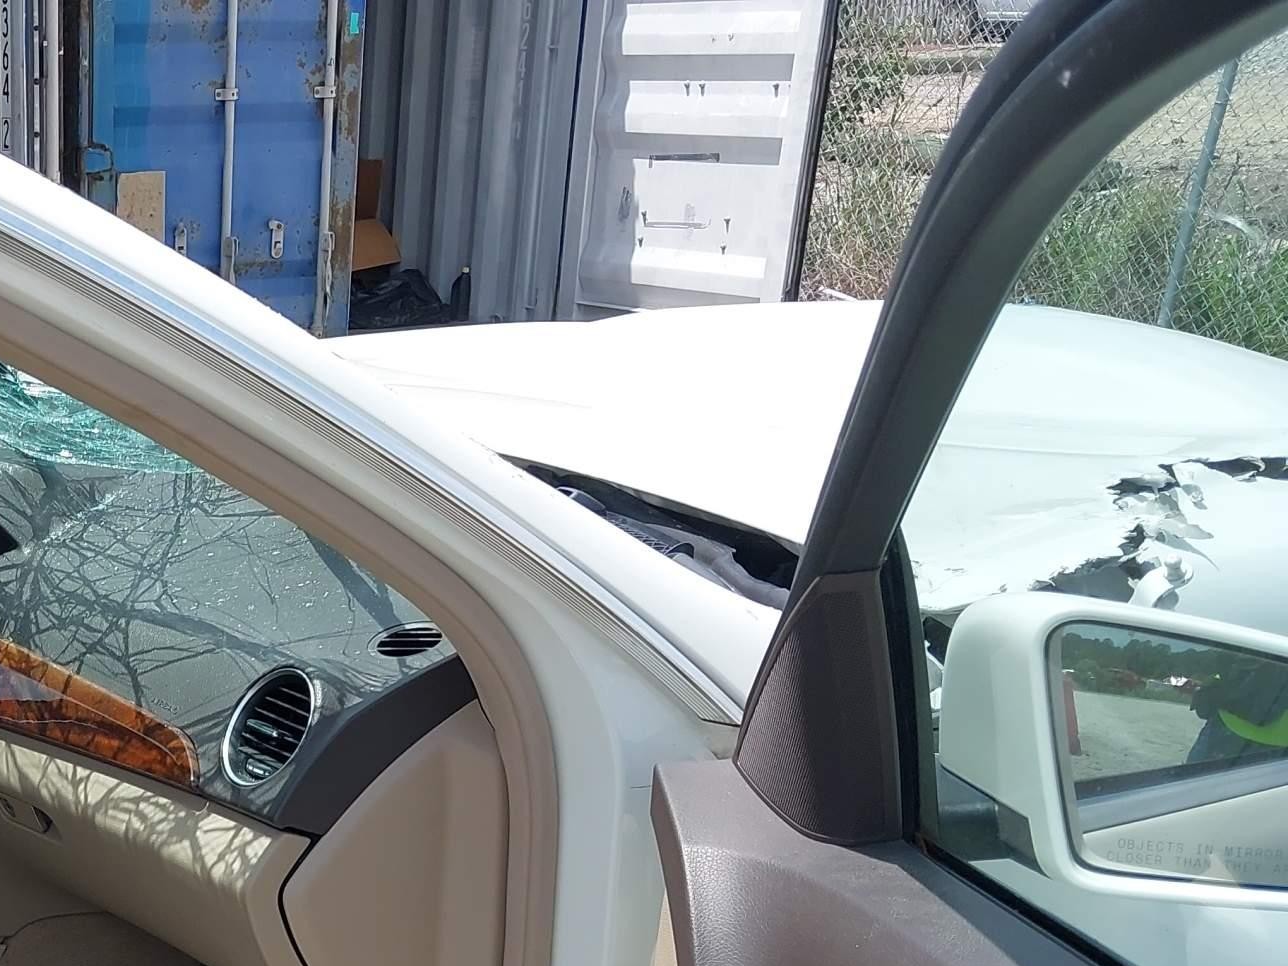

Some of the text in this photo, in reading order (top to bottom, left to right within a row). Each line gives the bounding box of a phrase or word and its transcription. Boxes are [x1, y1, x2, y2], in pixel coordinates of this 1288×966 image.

[1, 0, 10, 149] 364 2
[1116, 838, 1185, 852] OBJECTS
[1196, 843, 1215, 856] IN
[1105, 850, 1163, 865] CLOSER
[1175, 855, 1211, 869] THAN
